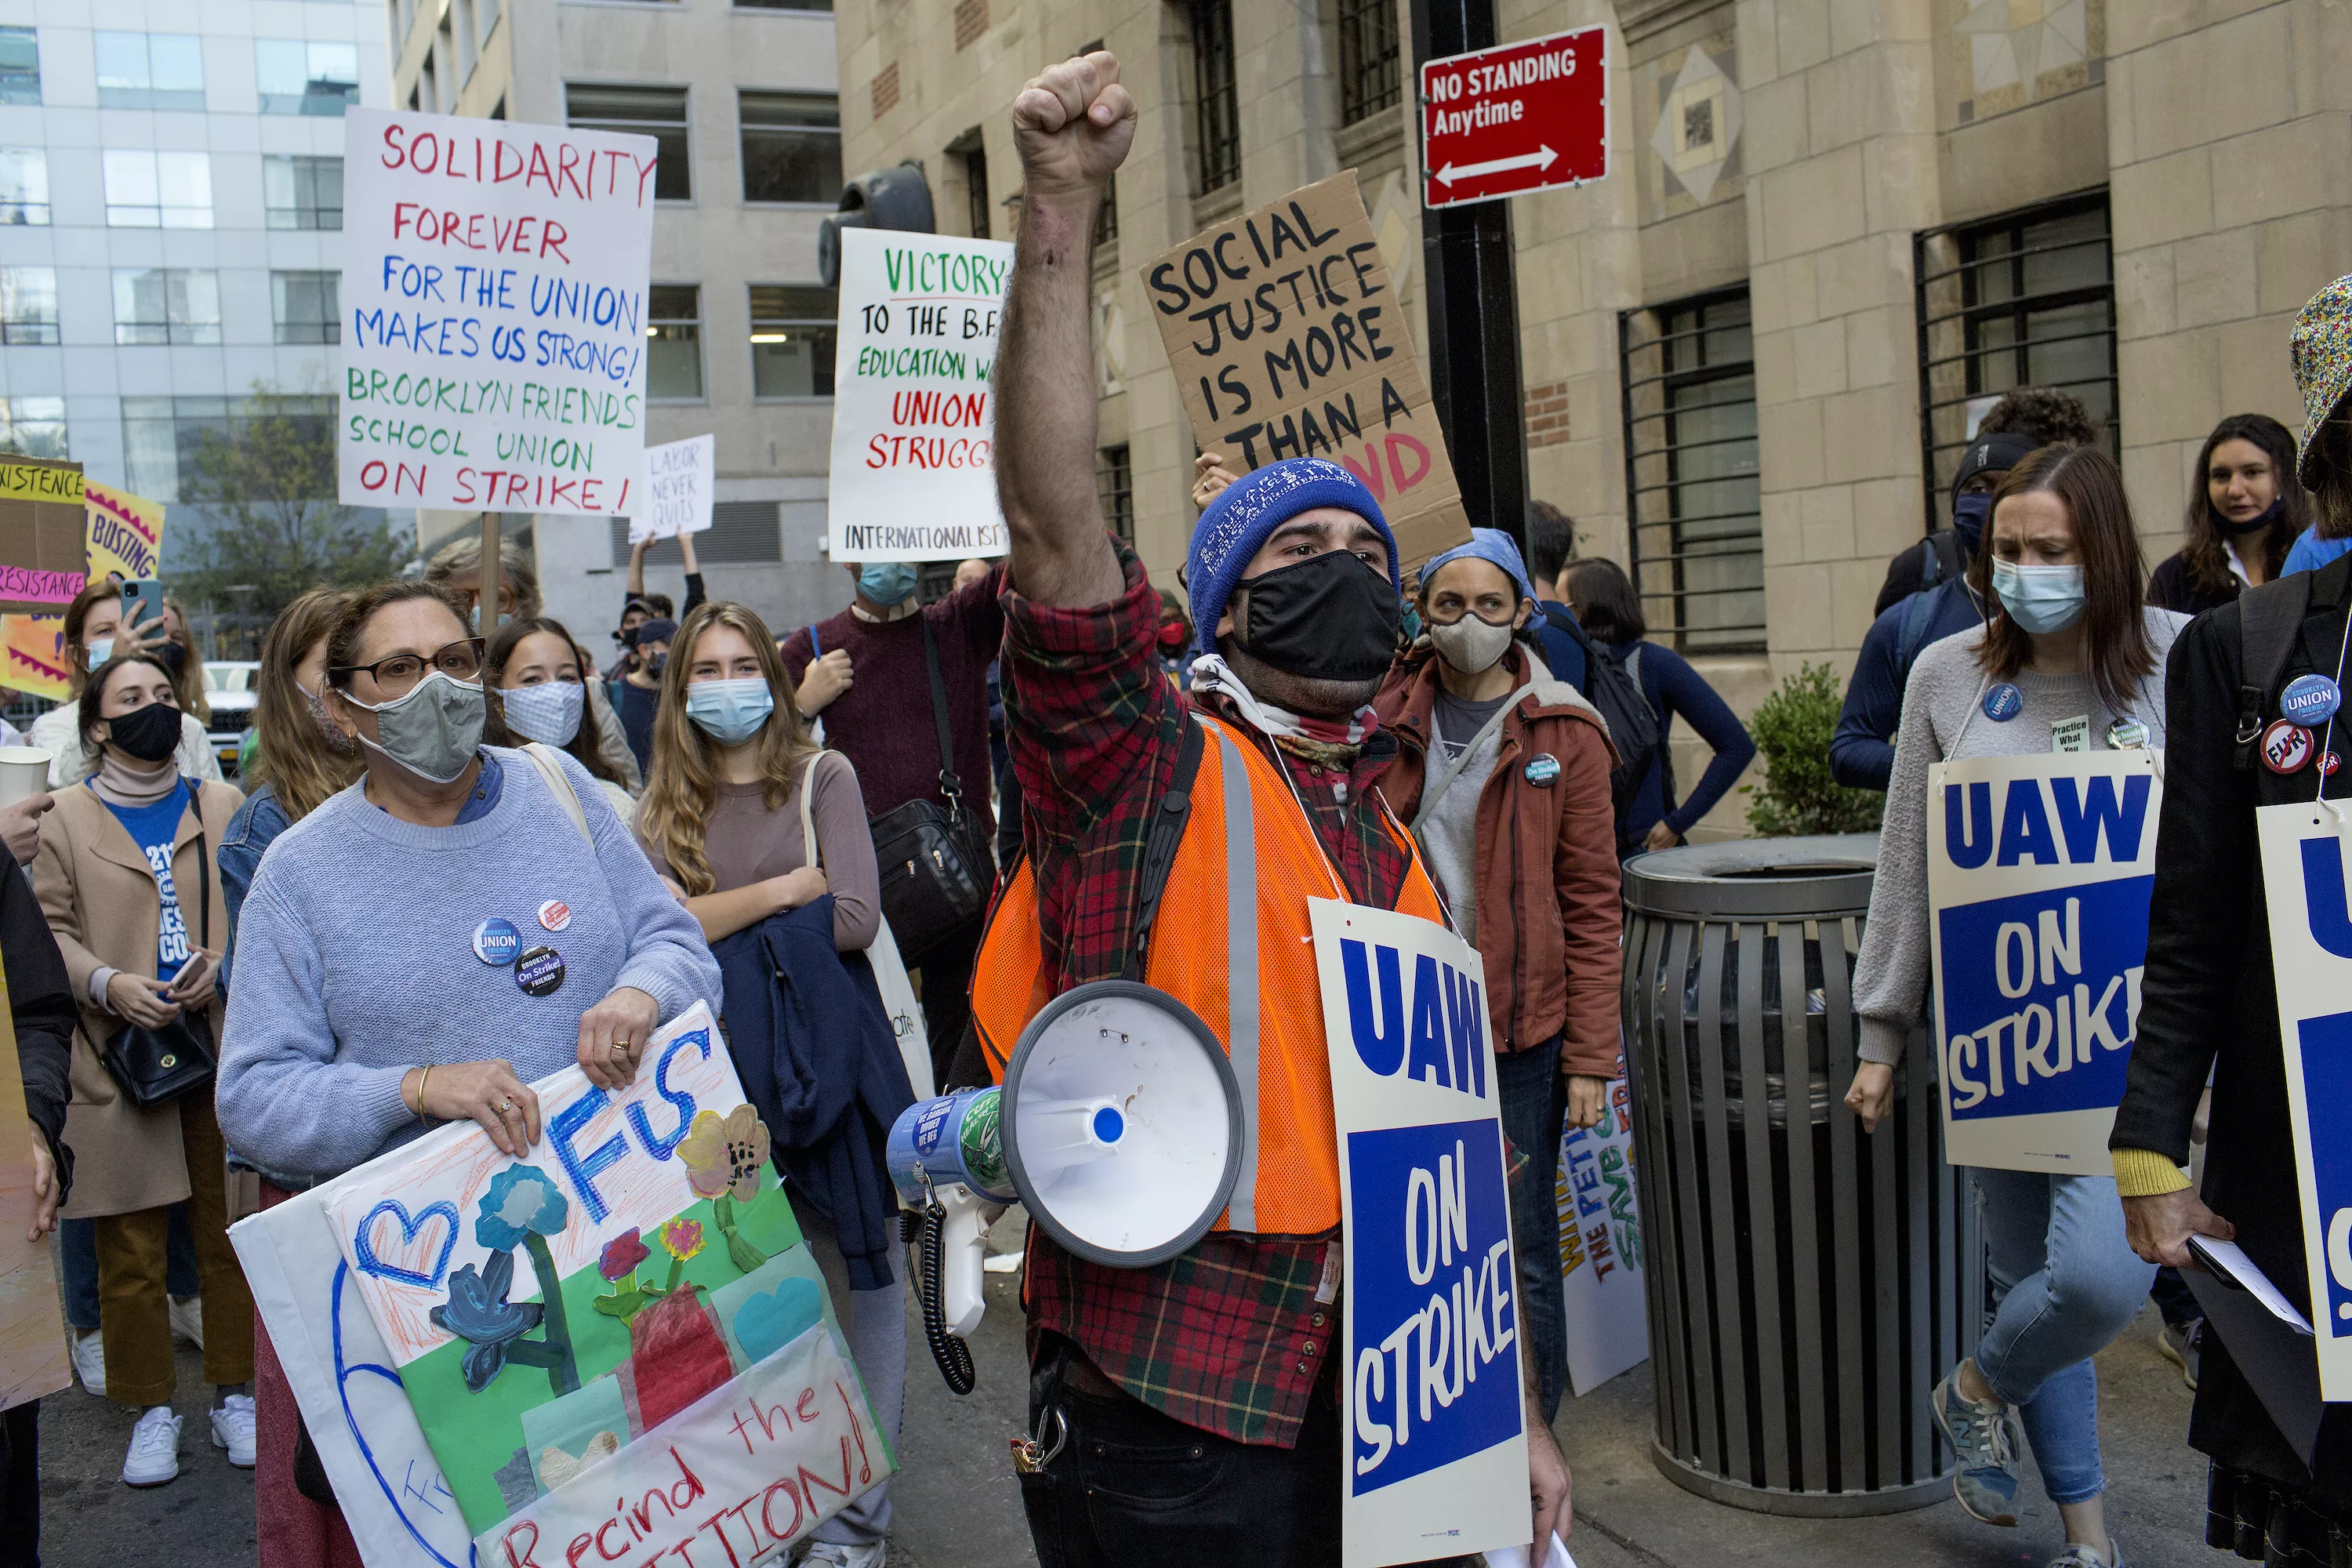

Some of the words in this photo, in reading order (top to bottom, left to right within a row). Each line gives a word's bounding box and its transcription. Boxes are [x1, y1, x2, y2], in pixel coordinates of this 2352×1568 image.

[1432, 73, 1462, 103] NO
[1468, 48, 1576, 96] STANDING
[1433, 99, 1524, 136] Anytime
[382, 125, 657, 208] SOLIDARITY
[394, 203, 569, 264] FOREVER
[885, 248, 1006, 296] VICTORY
[1149, 201, 1341, 315] SOCIAL
[384, 256, 445, 303] FOR
[456, 266, 517, 309] THE
[532, 274, 638, 336] UNION
[1189, 241, 1385, 357] JUSTICE
[862, 304, 889, 335] TO
[908, 306, 948, 336] THE
[356, 308, 481, 358] MAKES
[492, 325, 525, 363] US
[536, 330, 639, 387] STRONG!
[858, 346, 965, 380] EDUCATION
[1200, 365, 1252, 422] IS
[1265, 306, 1394, 400] MORE
[347, 368, 513, 414] BROOKLYN
[522, 382, 640, 429] FRIENDS
[893, 390, 986, 428] UNION
[1225, 393, 1363, 471] THAN
[1382, 377, 1412, 430] A
[350, 416, 468, 457] SCHOOL
[497, 434, 592, 472] UNION
[650, 442, 700, 475] LABOR
[866, 434, 994, 470] STRUGG
[360, 460, 426, 497] ON
[452, 466, 630, 516] STRIKE!
[652, 473, 696, 500] NEVER
[652, 498, 695, 528] QUITS
[92, 514, 157, 579] BUSTING
[1992, 687, 2013, 715] UNION
[2288, 689, 2332, 710] UNION
[2292, 684, 2325, 697] BROOKLYN
[2298, 703, 2325, 714] FRIENDS
[2052, 721, 2086, 735] Practice
[2060, 733, 2081, 746] What
[2267, 730, 2306, 766] FUR
[1944, 775, 2152, 869] UAW
[550, 902, 564, 916] UNION
[480, 935, 516, 948] UNION
[1995, 897, 2082, 999] ON
[518, 972, 532, 982] On
[533, 959, 561, 978] Strike!
[521, 953, 550, 970] BROOKLYN
[531, 972, 556, 987] FRIENDS
[1340, 938, 1486, 1099] UAW
[917, 1112, 929, 1124] WE
[920, 1117, 941, 1134] DIVIDED
[919, 1134, 927, 1147] WE
[927, 1129, 938, 1143] BEG
[1406, 1139, 1468, 1286] ON
[1586, 1222, 1615, 1283] THE
[1356, 1239, 1514, 1476] STRIKE
[502, 1446, 706, 1568] Recind
[728, 1387, 819, 1455] the
